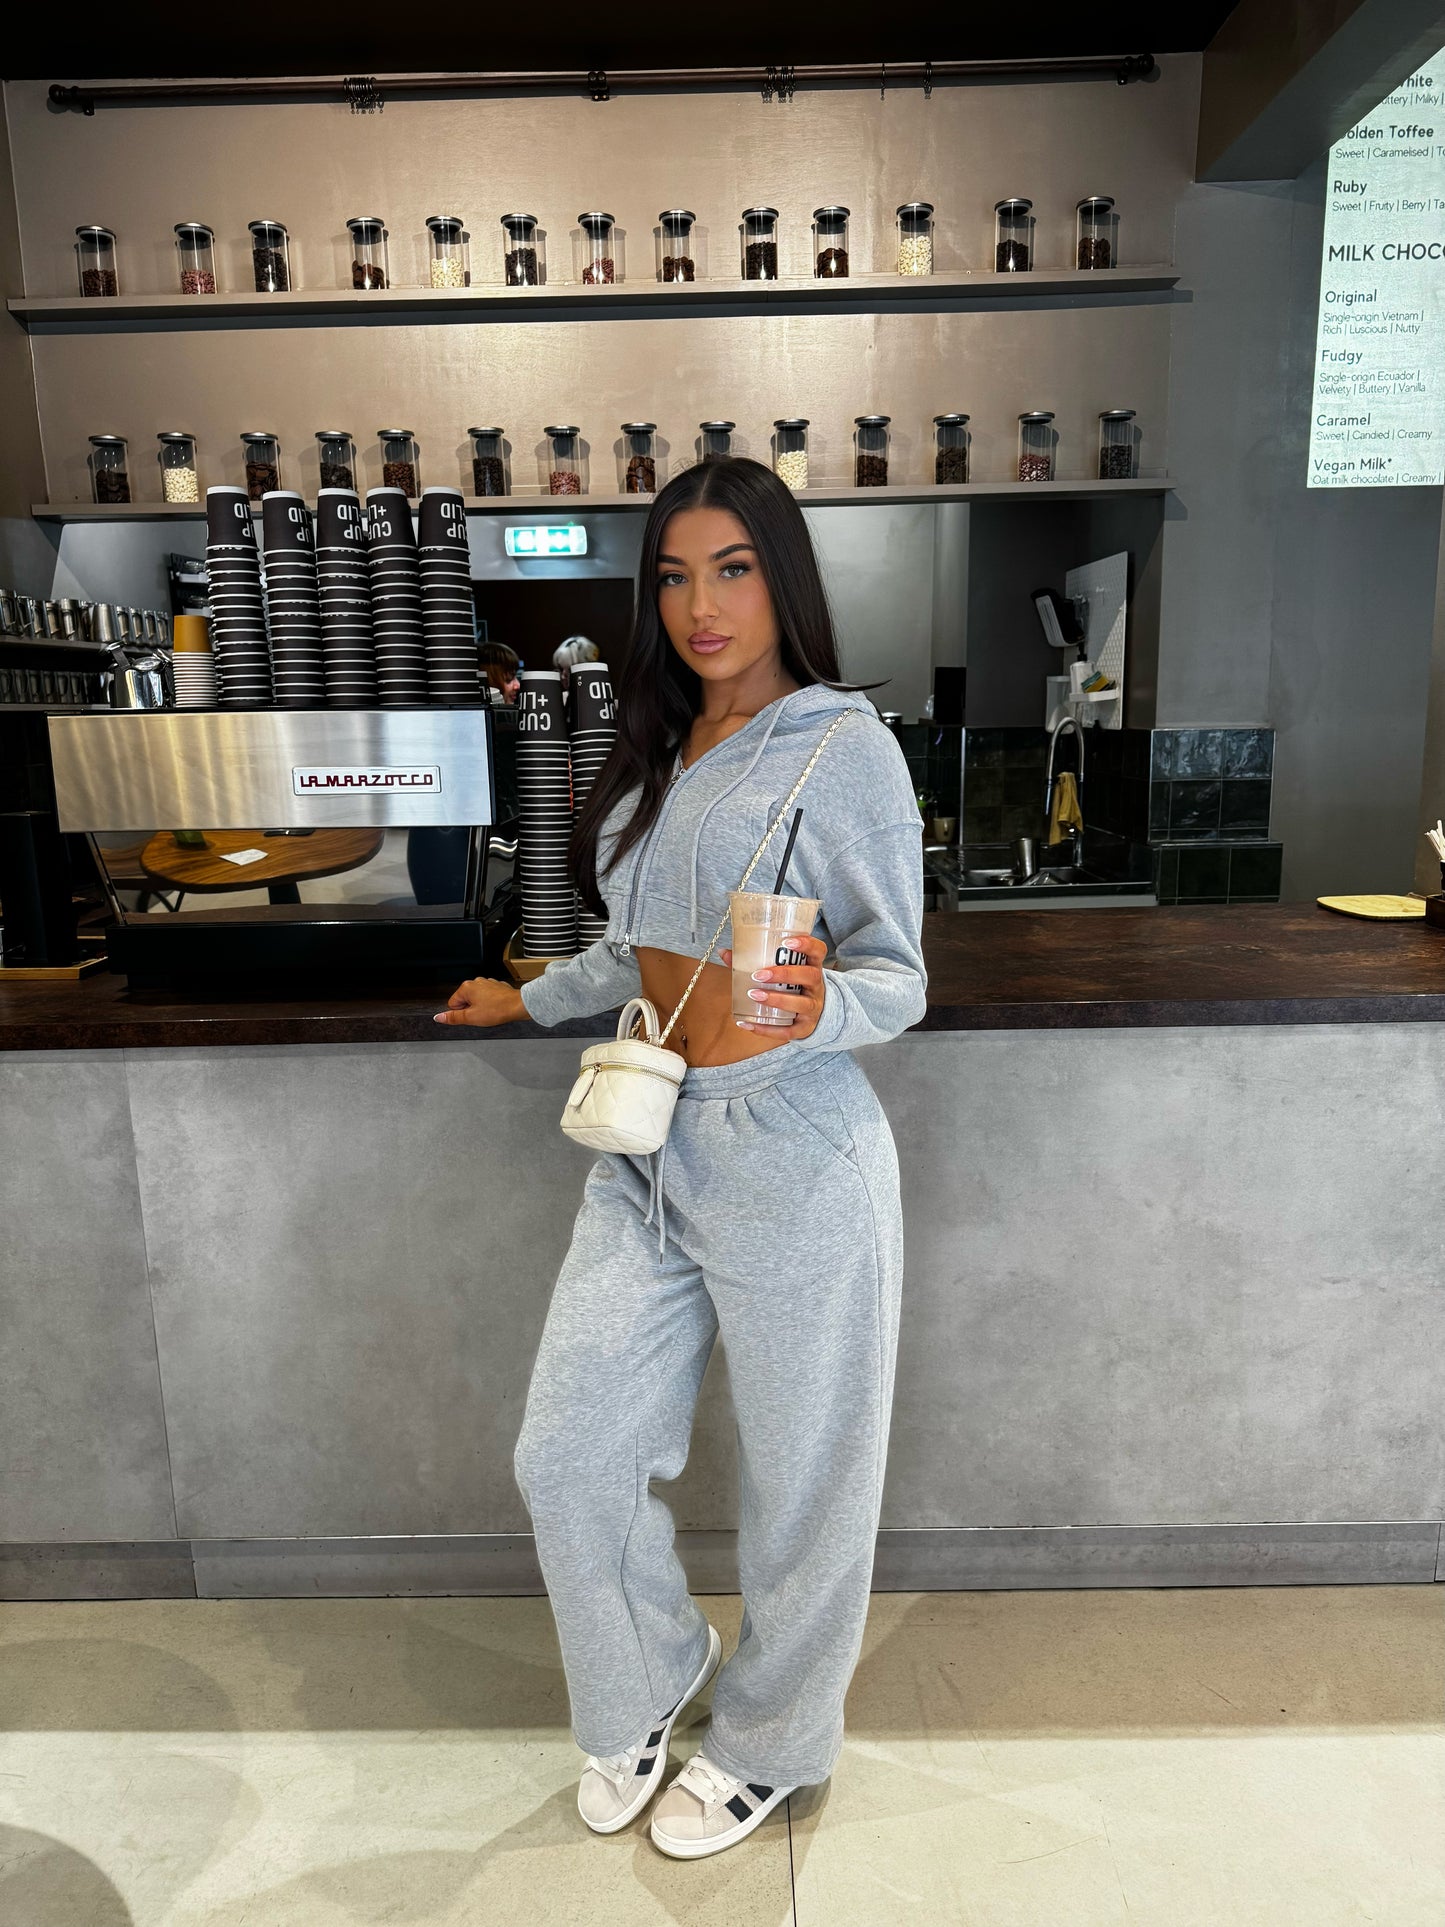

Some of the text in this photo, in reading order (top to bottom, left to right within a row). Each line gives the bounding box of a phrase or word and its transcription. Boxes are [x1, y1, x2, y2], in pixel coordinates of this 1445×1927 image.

[1401, 74, 1433, 88] hite
[1382, 93, 1440, 107] uttery Milky
[1342, 125, 1434, 139] olden Toffee
[1335, 148, 1365, 158] Sweet
[1372, 146, 1429, 158] Caramelised
[1333, 180, 1367, 195] Ruby
[1332, 201, 1361, 211] Sweet
[1369, 200, 1395, 212] Fruity
[1402, 199, 1426, 211] Berry
[1328, 242, 1445, 262] MILK CHOC
[1325, 289, 1377, 306] Original
[1323, 311, 1419, 324] Single-origin Vietnam
[1322, 324, 1420, 335] Rich Luscious Nutty
[1321, 349, 1363, 365] Fudgy
[1319, 370, 1415, 384] Single-origin Ecuador
[1319, 382, 1426, 396] Velvety Buttery Vanilla
[1316, 412, 1371, 426] Caramel
[1316, 428, 1433, 441] Sweet Candied Creamy
[1314, 458, 1355, 475] Vegan
[1312, 472, 1437, 485] Oat milk chocolate Creamy
[336, 504, 360, 522] LID
[368, 504, 387, 522] +LI
[440, 502, 463, 521] LID
[343, 523, 362, 541] UP
[446, 522, 466, 540] UP
[589, 681, 613, 699] LID
[519, 712, 551, 731] CUP
[300, 774, 433, 787] LA MARZOCCO
